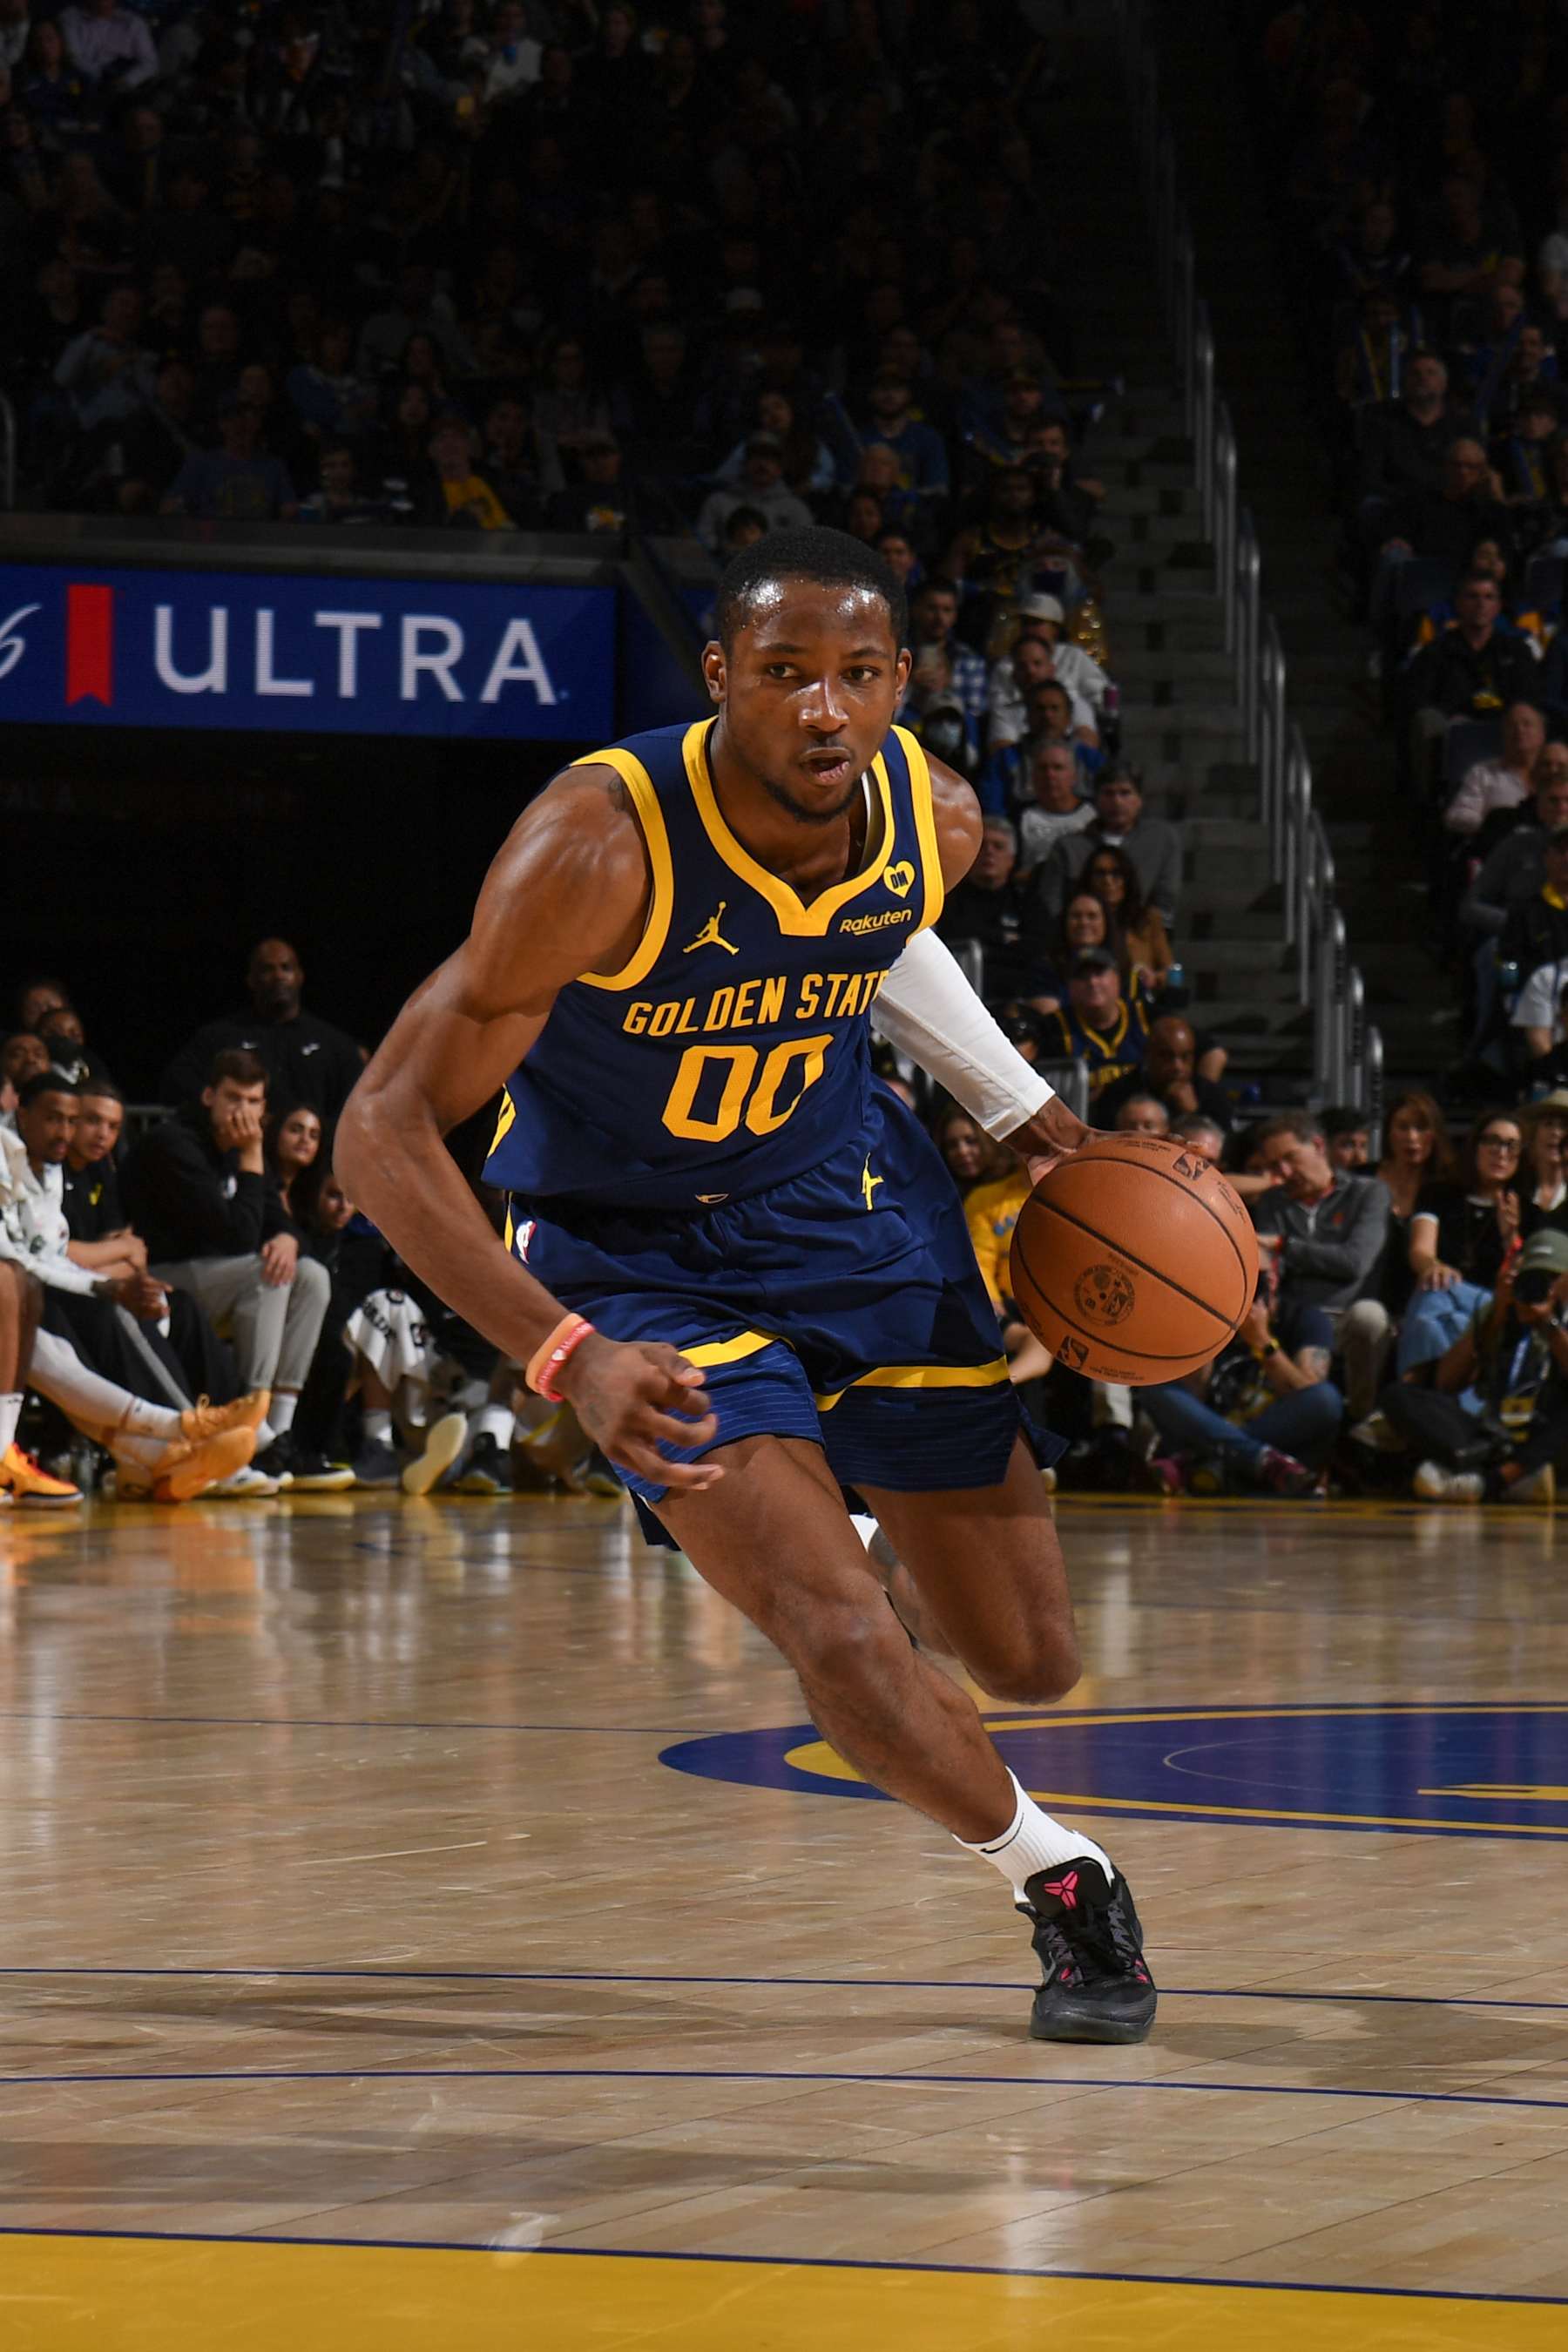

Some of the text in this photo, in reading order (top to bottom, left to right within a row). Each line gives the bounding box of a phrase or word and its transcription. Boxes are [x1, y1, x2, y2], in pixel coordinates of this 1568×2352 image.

[154, 605, 558, 706] ULTRA
[889, 870, 909, 889] DM
[839, 908, 912, 936] Rakuten
[622, 975, 787, 1037] GOLDEN
[661, 1033, 835, 1143] 00
